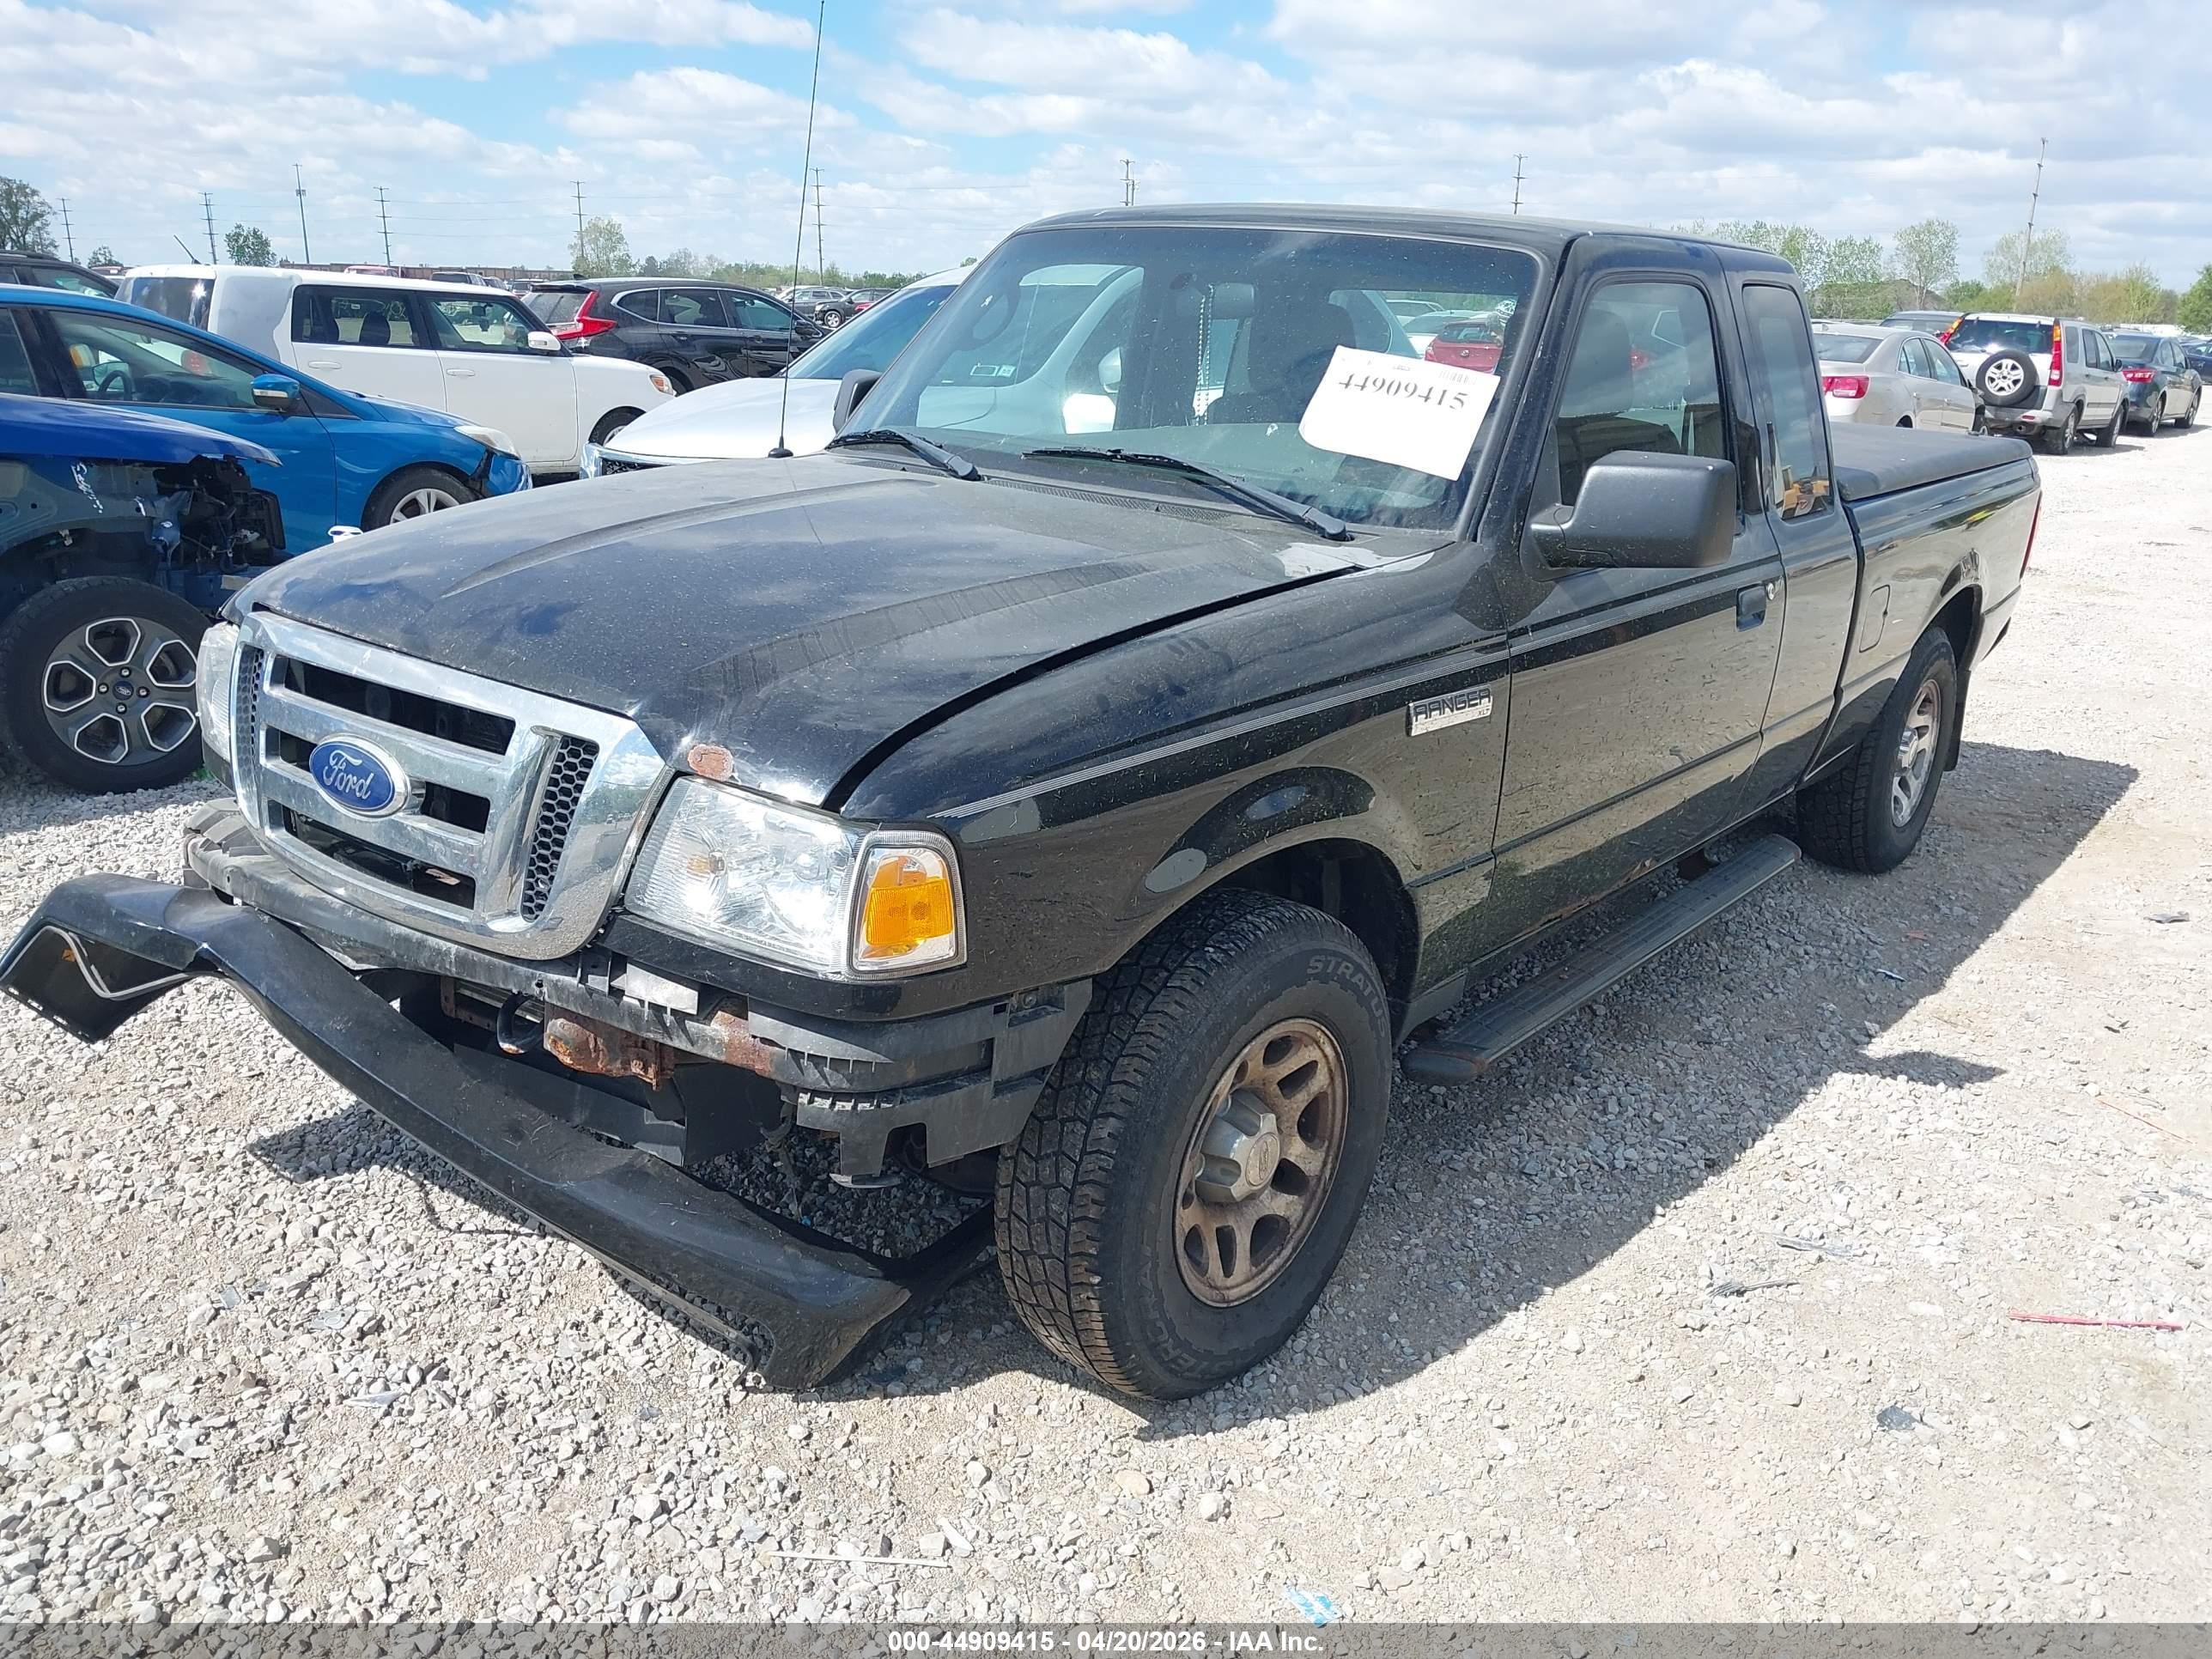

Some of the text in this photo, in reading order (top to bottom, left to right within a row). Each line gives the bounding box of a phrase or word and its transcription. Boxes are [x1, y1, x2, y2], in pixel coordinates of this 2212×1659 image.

[1339, 373, 1468, 410] 44909415
[1413, 688, 1491, 722] RANGER
[1478, 708, 1490, 716] XLT
[322, 750, 374, 799] Ford
[1307, 955, 1387, 1037] STRATUS
